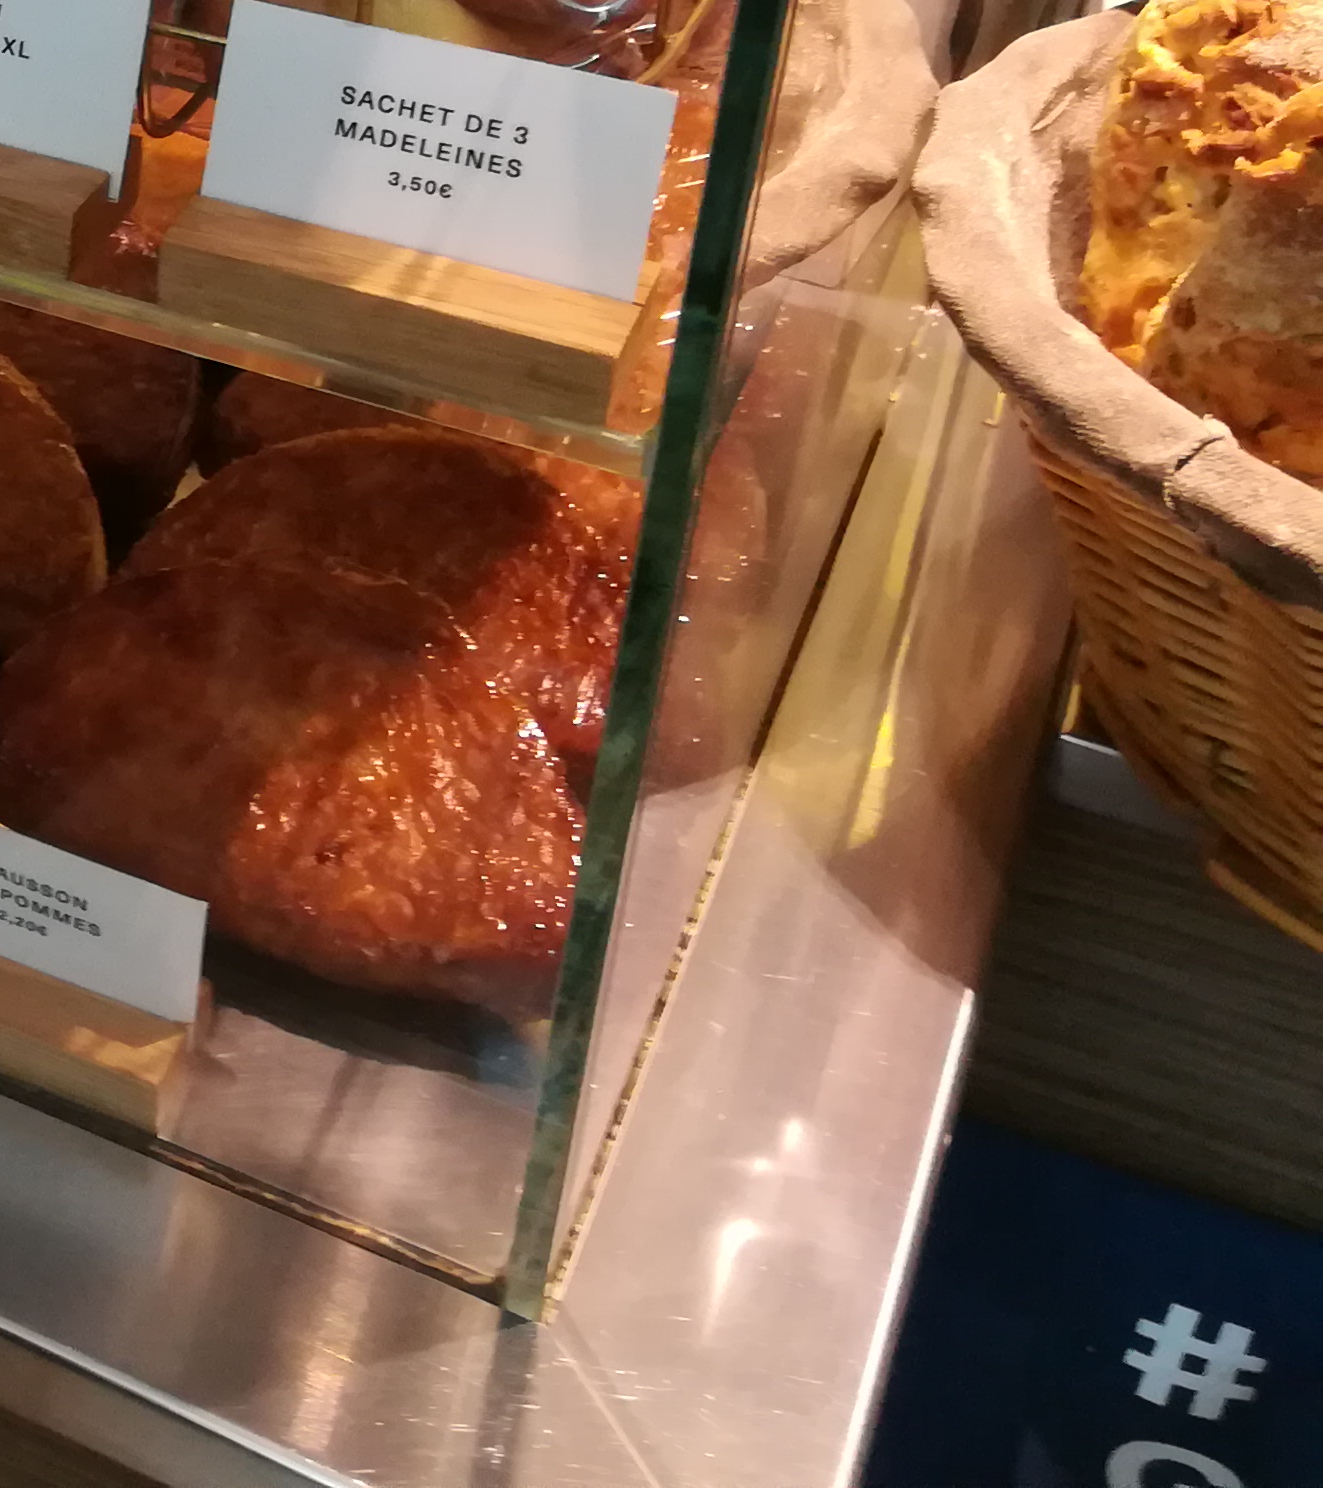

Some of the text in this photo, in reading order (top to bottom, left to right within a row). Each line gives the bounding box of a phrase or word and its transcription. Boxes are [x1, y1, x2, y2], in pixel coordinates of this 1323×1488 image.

[2, 36, 31, 59] XL
[340, 85, 530, 144] SACHET DE 3
[334, 118, 523, 179] MADELEINES
[387, 171, 453, 200] 3,50€
[0, 888, 101, 937] POMMES
